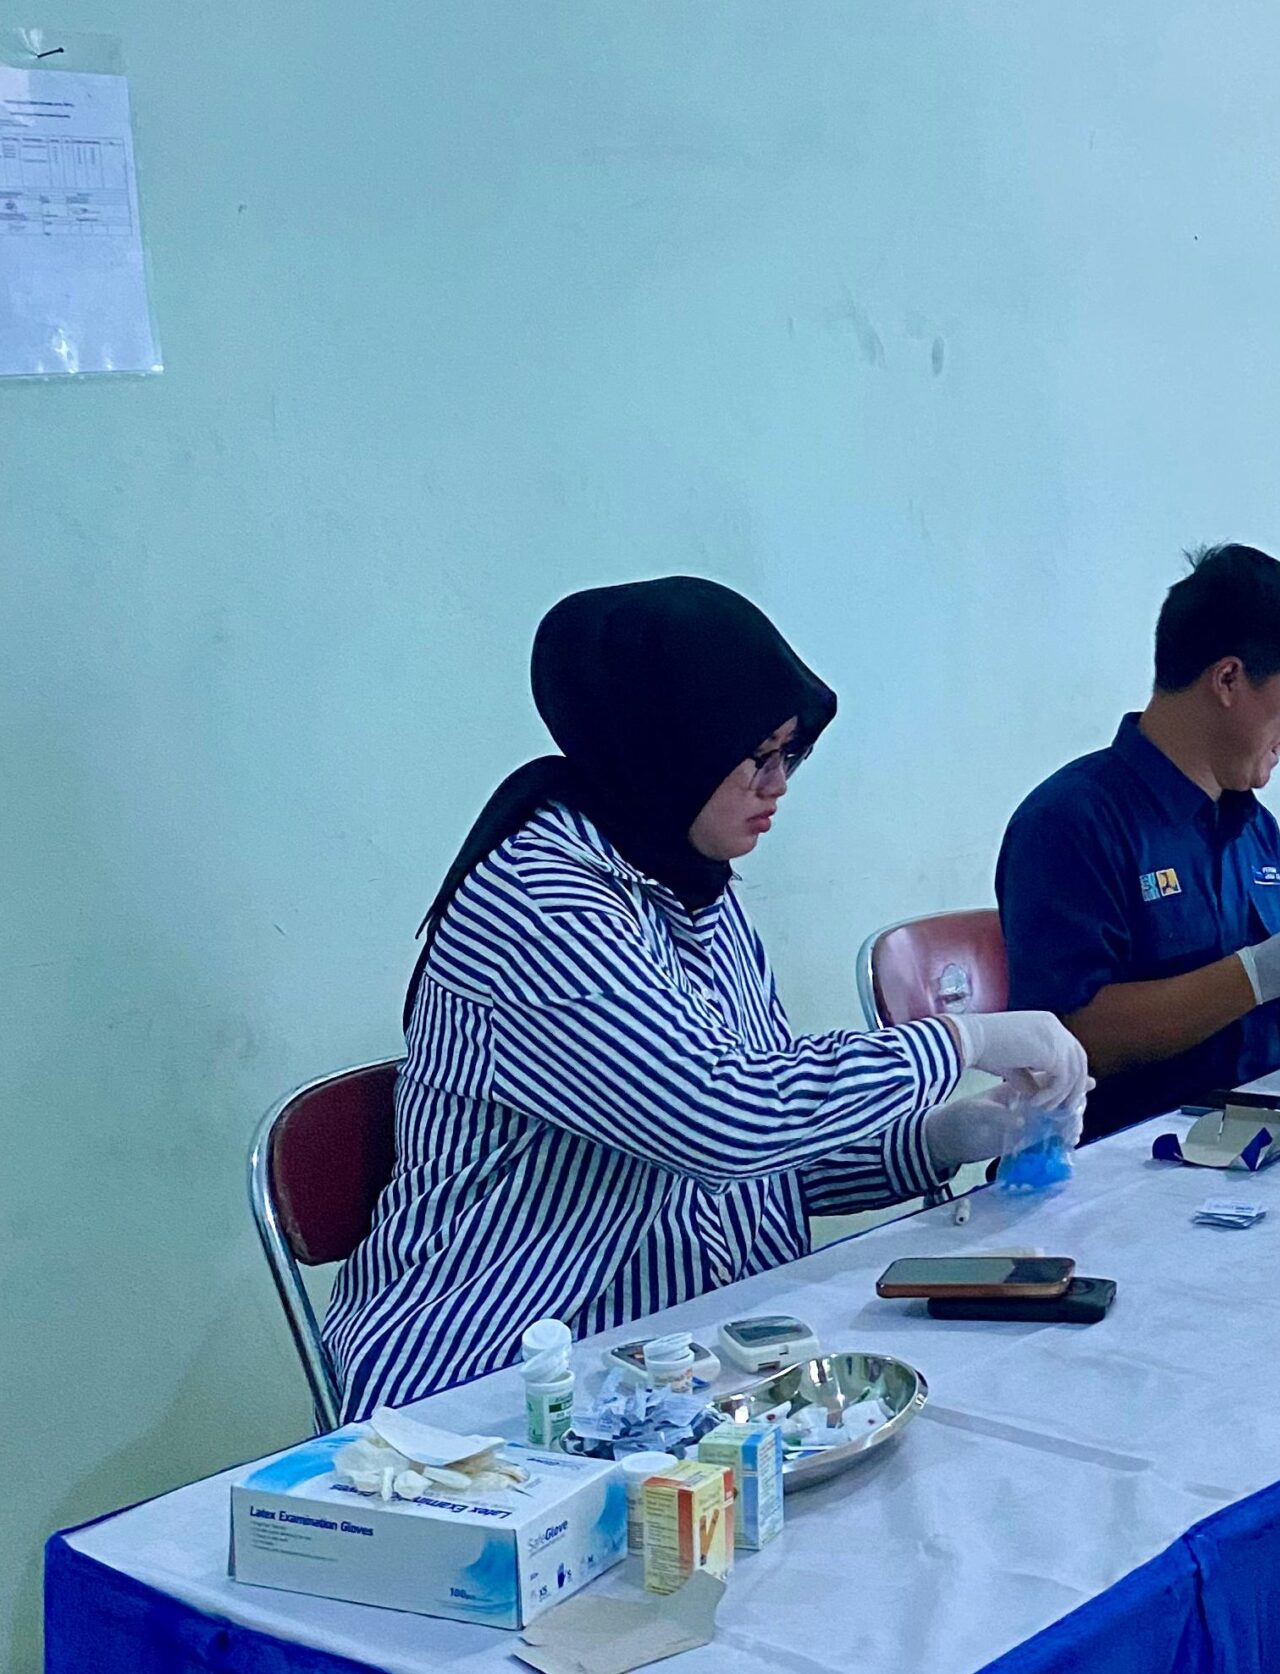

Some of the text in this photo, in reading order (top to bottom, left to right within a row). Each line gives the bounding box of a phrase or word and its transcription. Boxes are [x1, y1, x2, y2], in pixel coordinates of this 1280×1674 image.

[249, 1505, 374, 1536] Latex Examination Gloves
